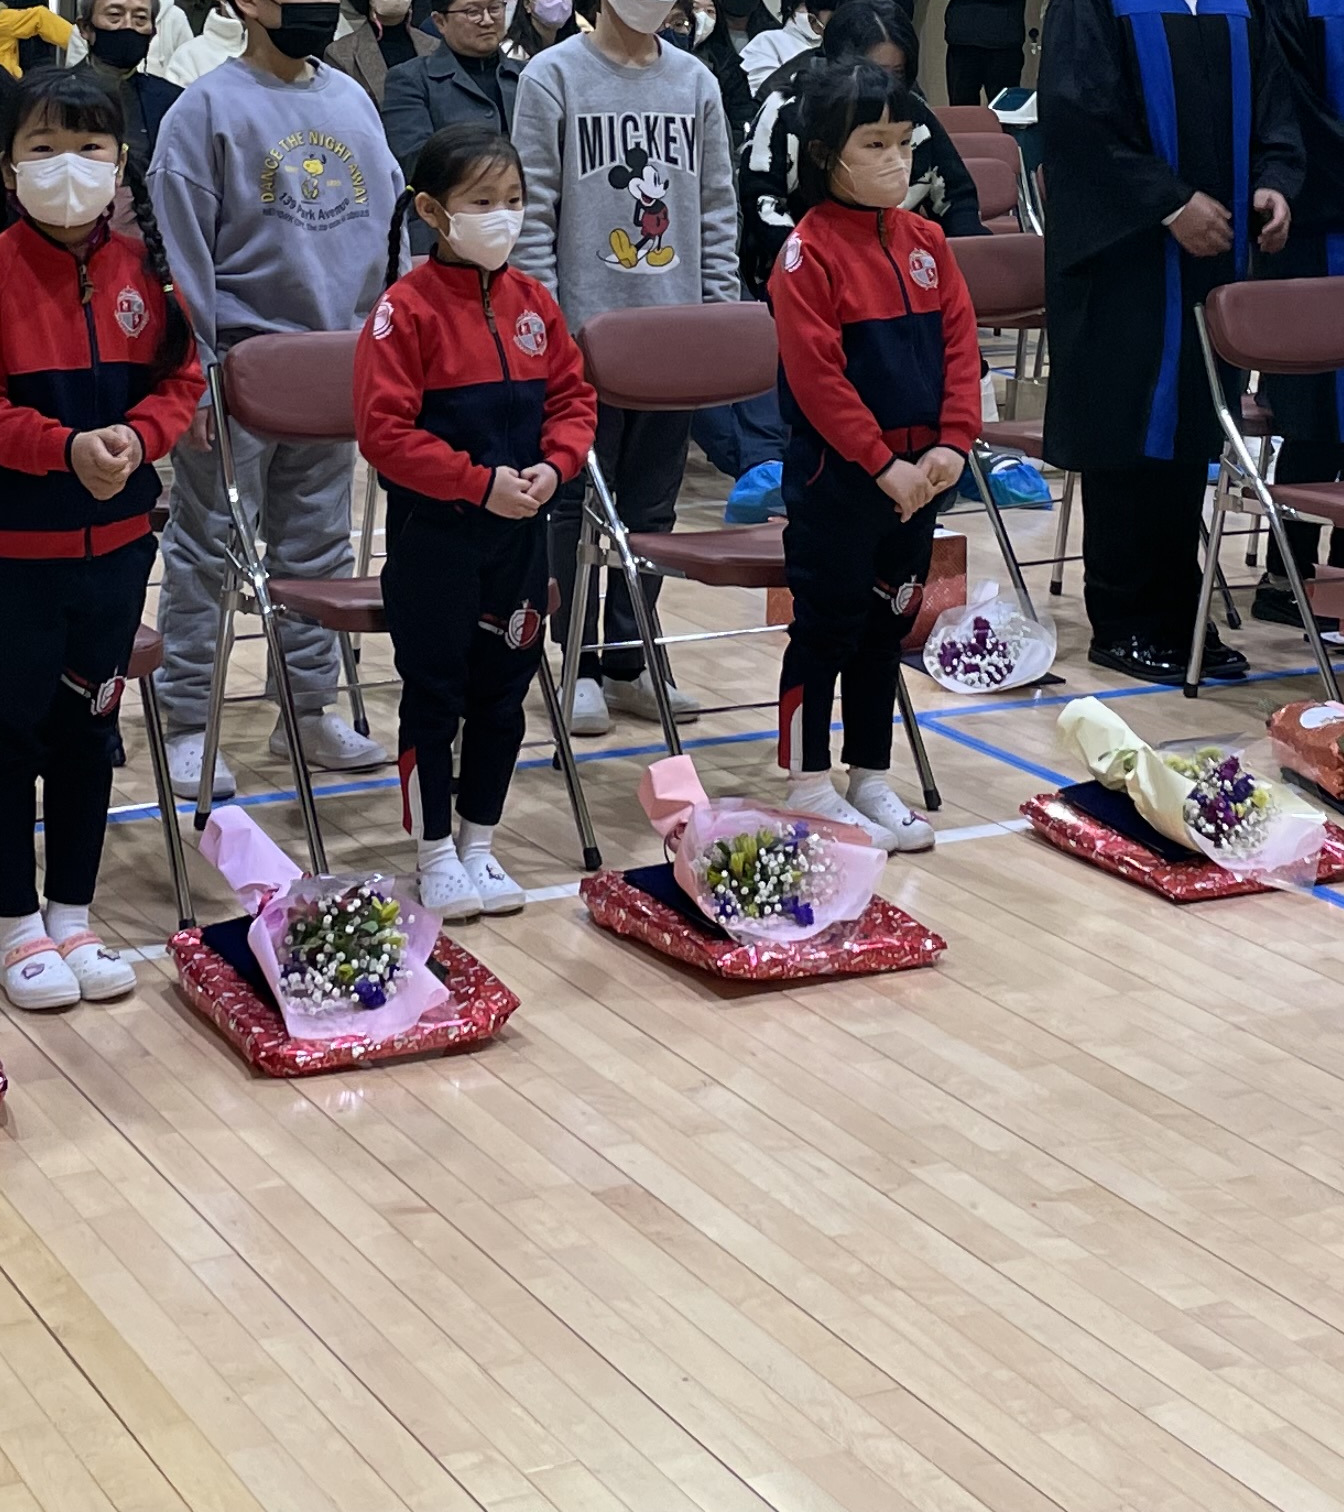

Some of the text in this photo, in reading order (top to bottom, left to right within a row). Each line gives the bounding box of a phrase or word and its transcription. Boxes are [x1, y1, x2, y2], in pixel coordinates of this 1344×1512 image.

[260, 130, 369, 204] DANCE THE NIGHT AWAY
[575, 112, 697, 180] MICKEY
[297, 204, 316, 221] Park
[318, 197, 350, 221] Avenue
